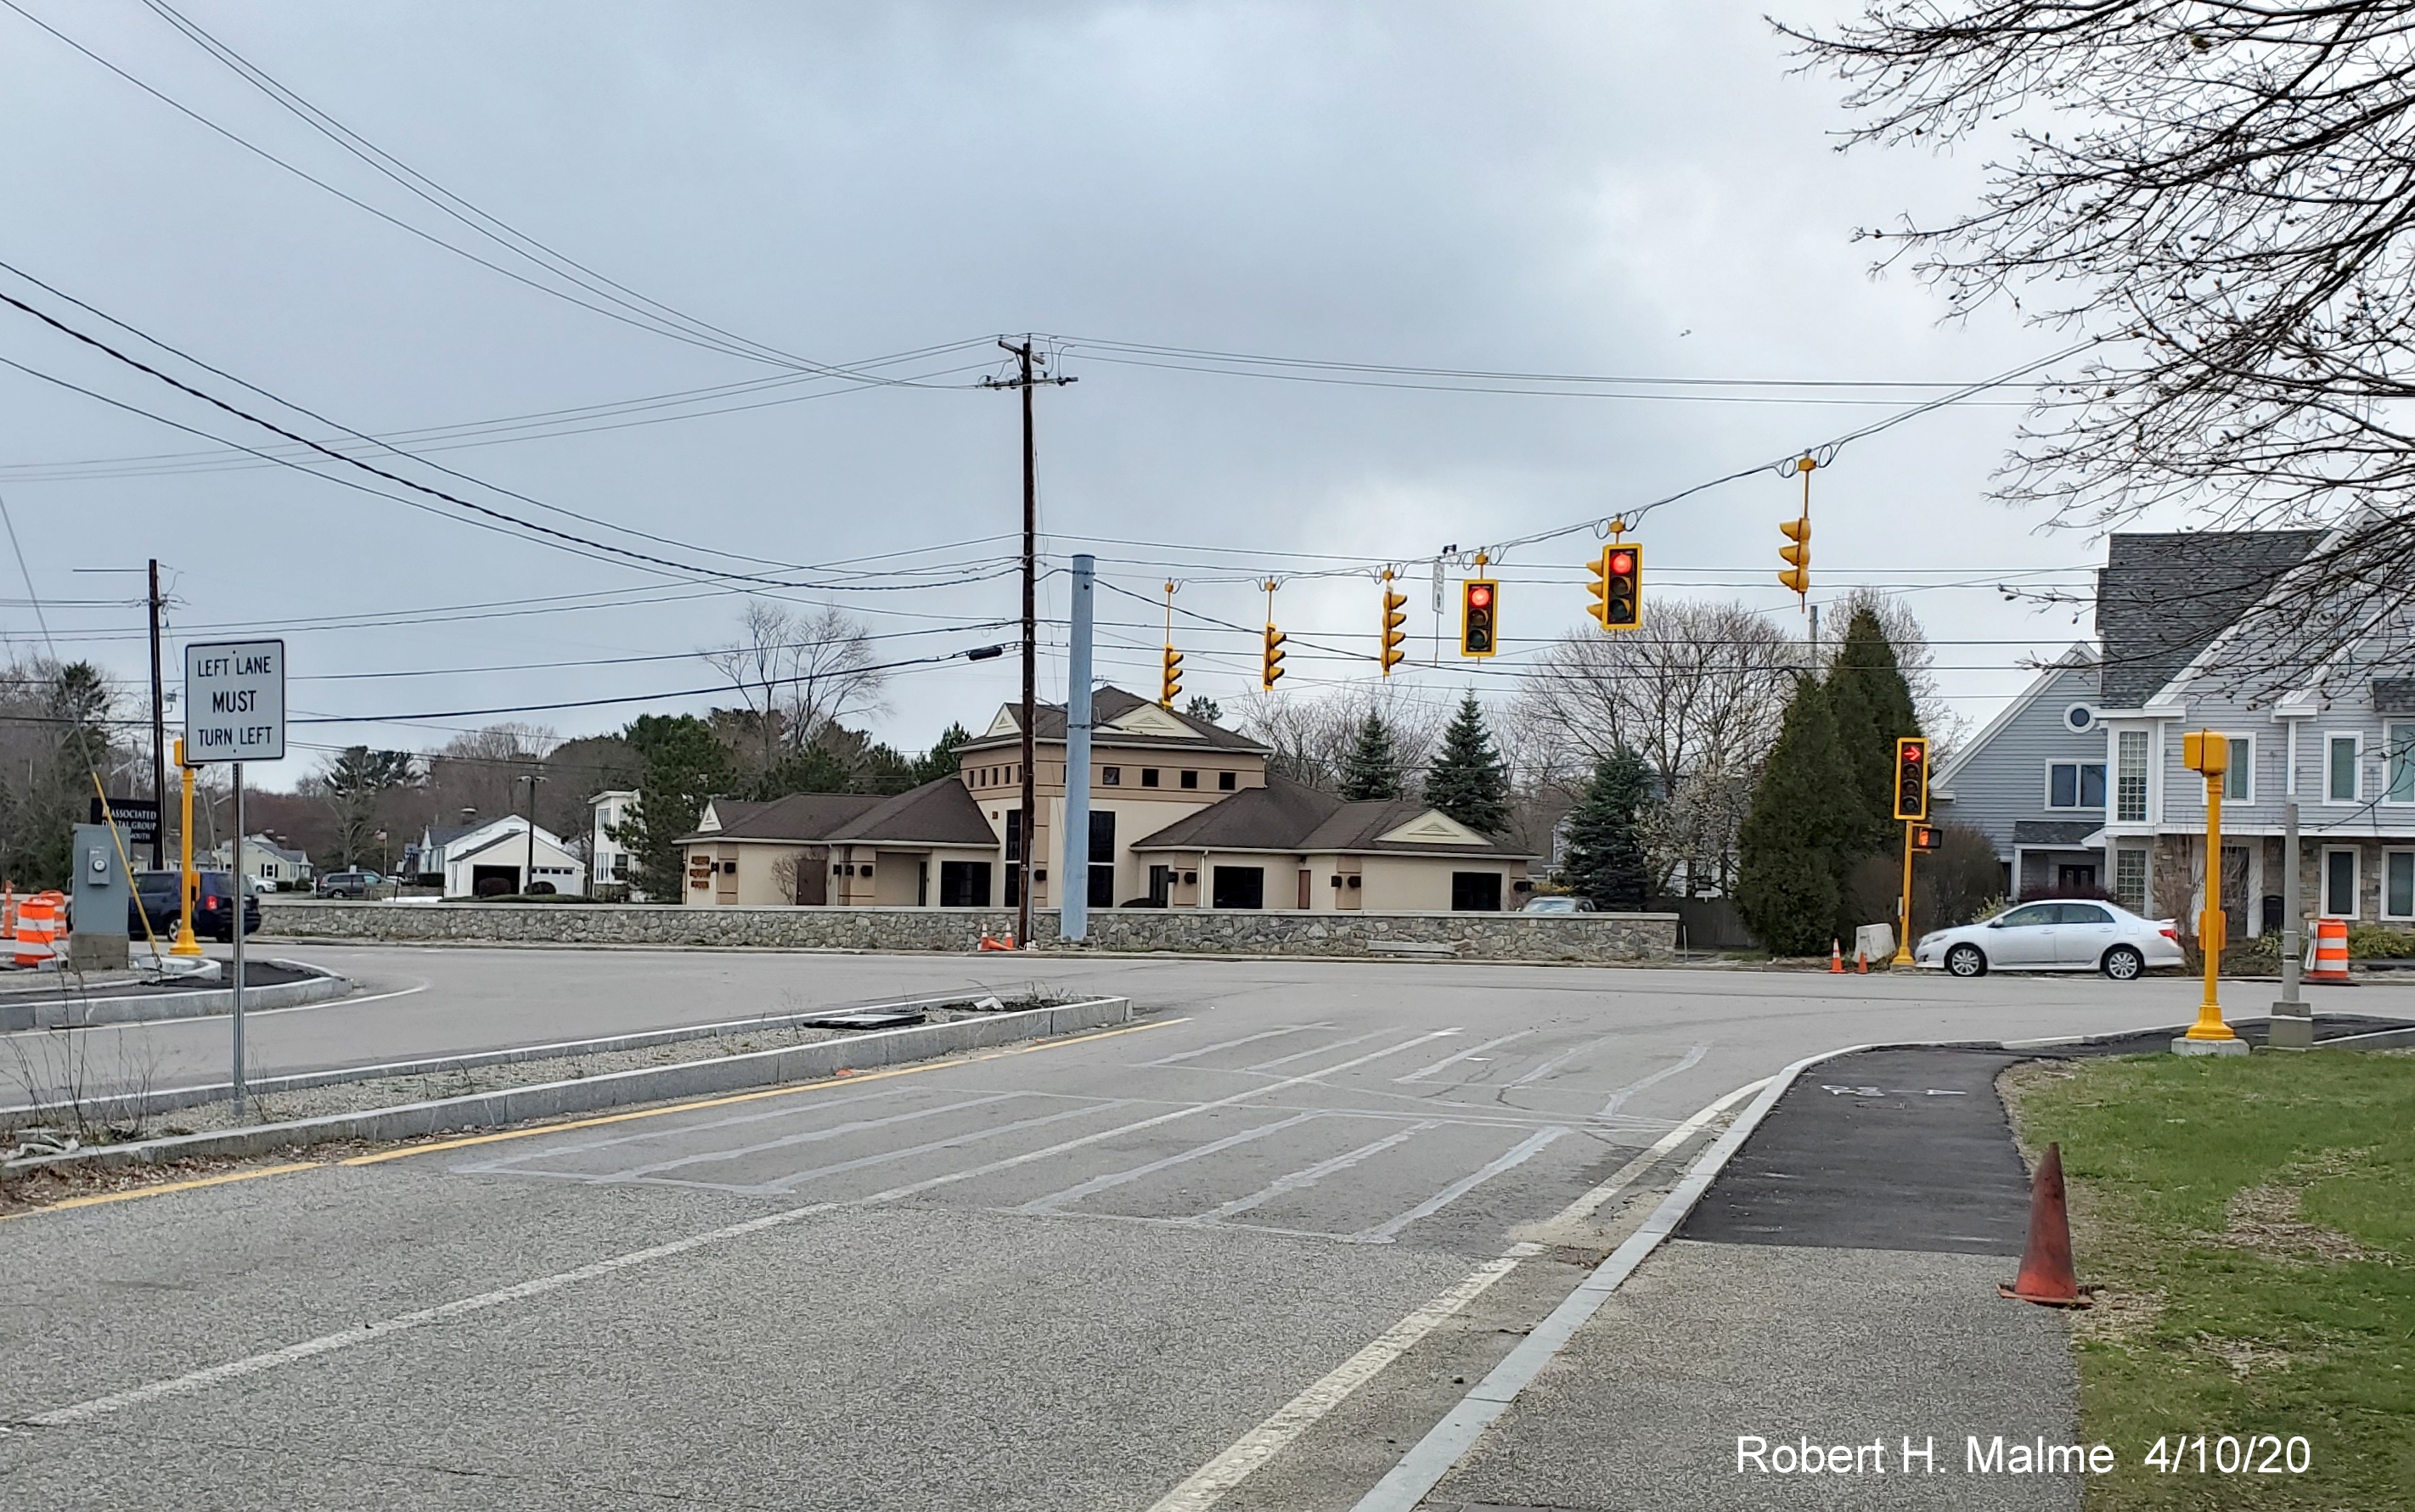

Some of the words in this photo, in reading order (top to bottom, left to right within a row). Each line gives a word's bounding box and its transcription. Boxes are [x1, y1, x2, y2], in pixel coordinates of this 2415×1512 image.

[198, 658, 229, 677] LEFT
[236, 655, 272, 676] LANE
[212, 689, 256, 713] MUST
[198, 728, 233, 747] TURN
[239, 726, 273, 745] LEFT
[131, 821, 157, 831] GROUP
